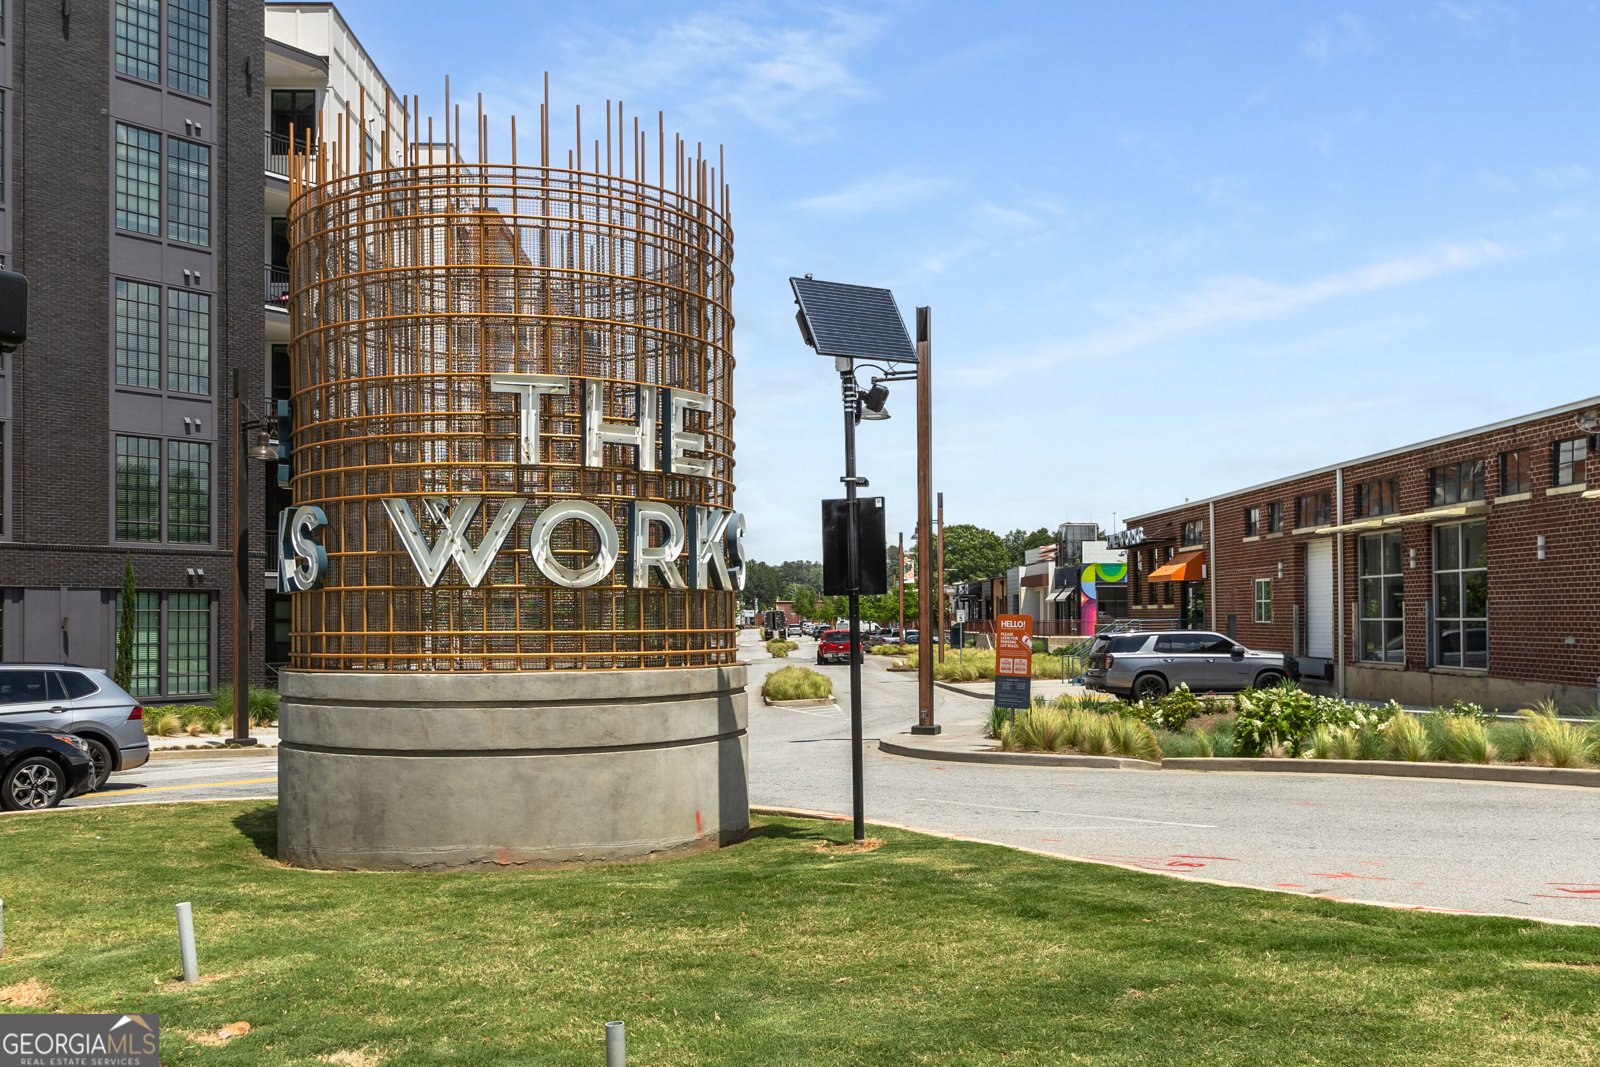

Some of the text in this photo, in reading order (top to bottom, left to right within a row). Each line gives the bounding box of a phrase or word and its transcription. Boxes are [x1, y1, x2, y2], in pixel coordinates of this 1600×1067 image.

[490, 373, 714, 477] THE
[382, 497, 747, 592] WORKS
[1001, 620, 1026, 628] HELLO!
